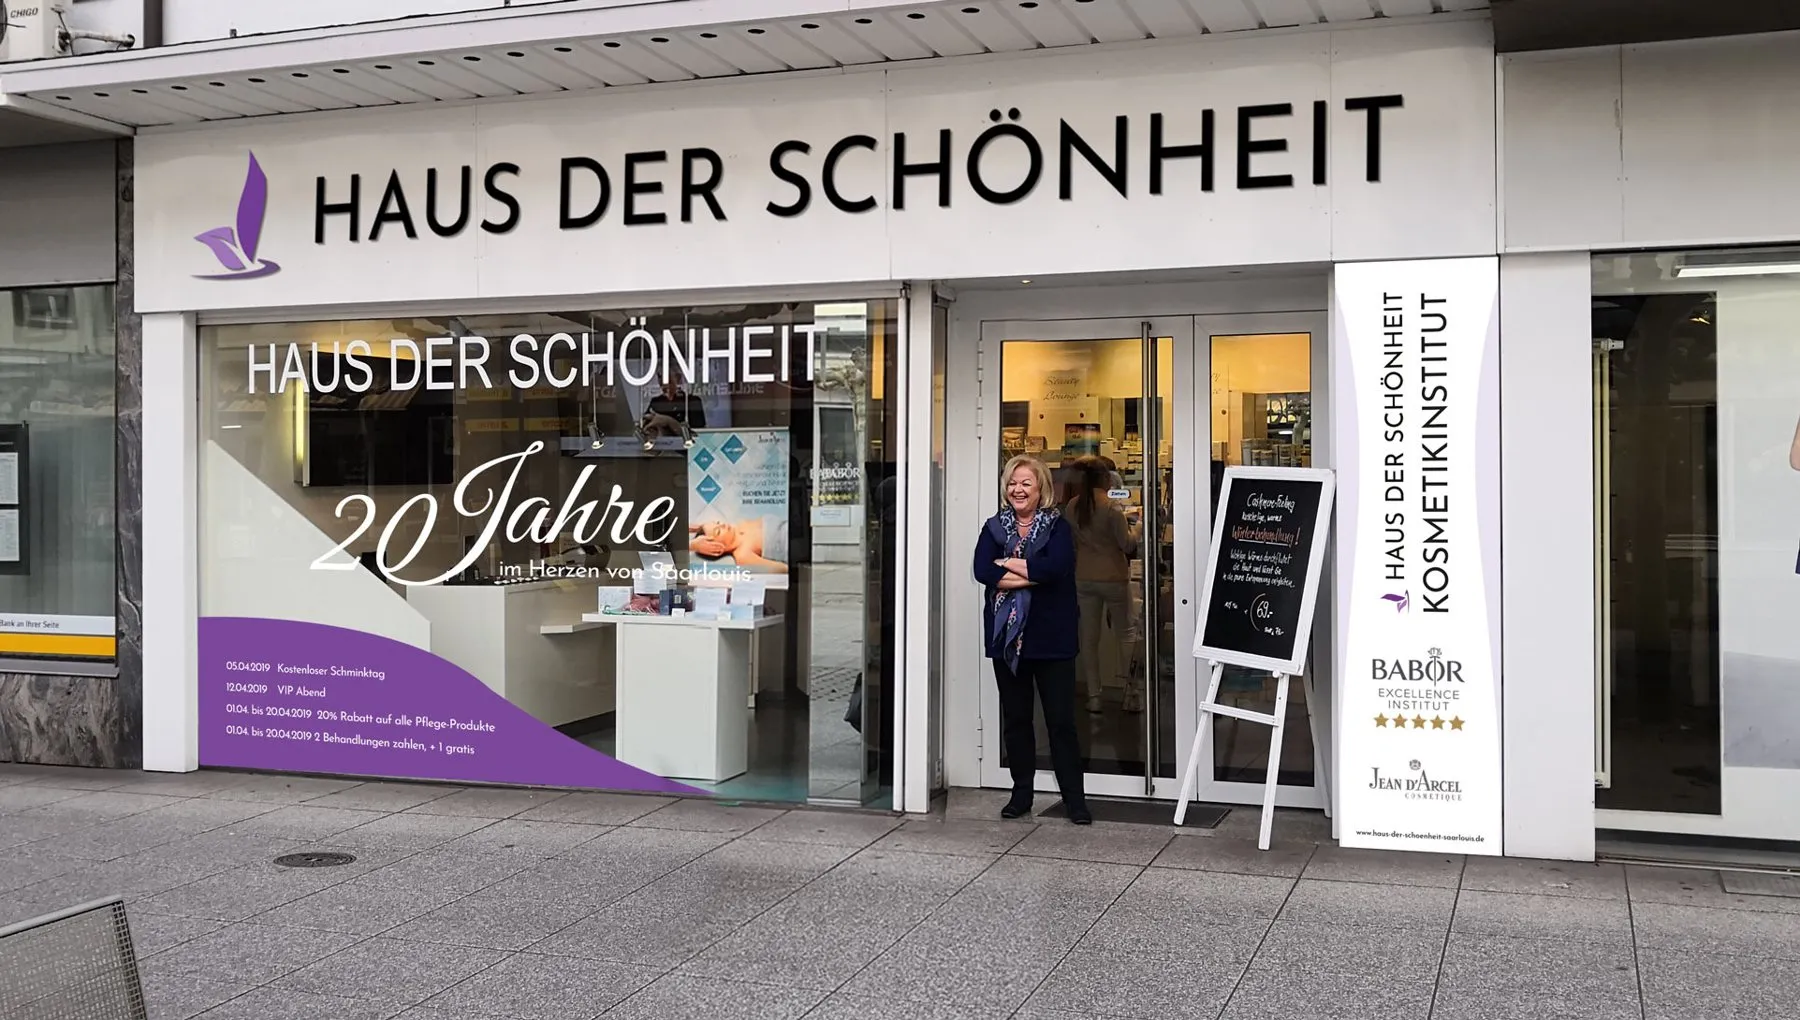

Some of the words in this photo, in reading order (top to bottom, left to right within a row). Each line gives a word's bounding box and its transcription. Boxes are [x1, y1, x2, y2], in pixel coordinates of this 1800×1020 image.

[10, 7, 38, 18] CHIGO
[314, 162, 522, 245] HAUS
[558, 147, 728, 230] DER
[765, 94, 1405, 218] SCHÖNHEIT
[248, 339, 374, 394] HAUS
[390, 336, 492, 391] DER
[508, 317, 829, 389] SCHÖNHEIT
[1380, 292, 1404, 442] SCHÖNHEIT
[1420, 293, 1449, 613] KOSMETIKINSTITUT
[1384, 452, 1404, 502] DER
[309, 494, 438, 575] 20
[380, 440, 679, 587] Jahre
[1385, 513, 1405, 579] HAUS
[499, 561, 522, 577] im
[529, 561, 600, 579] Herzen
[607, 567, 643, 581] von
[650, 560, 752, 582] Saarlouis
[226, 661, 271, 673] 05.04.2019
[277, 663, 328, 676] Kostenloser
[330, 665, 386, 680] Schminktag
[1372, 655, 1466, 686] BABOR
[226, 682, 268, 693] 12.04.2019
[277, 684, 294, 695] VIP
[296, 686, 326, 698] Abend
[1378, 688, 1460, 700] EXCELLENCE
[226, 703, 249, 714] 01.04.
[251, 704, 264, 716] bis
[265, 706, 312, 719] 20.04.2019
[317, 709, 338, 721] 20%
[340, 711, 373, 723] Rabatt
[375, 714, 392, 725] auf
[394, 714, 413, 727] alle
[415, 716, 496, 732] Pflege-Produkte
[1388, 700, 1450, 711] INSTITUT
[226, 725, 249, 736] 01.04.
[251, 726, 264, 738] bis
[265, 728, 312, 741] 20.04.2019
[314, 732, 321, 742] 2
[323, 733, 390, 749] Behandlungen
[393, 739, 427, 752] zahlen,
[438, 741, 443, 752] 1
[445, 743, 475, 755] gratis
[1404, 792, 1462, 801] COSMETIQUE
[1356, 828, 1485, 843] www.haus-der-schoenheit-saarlouis.de
